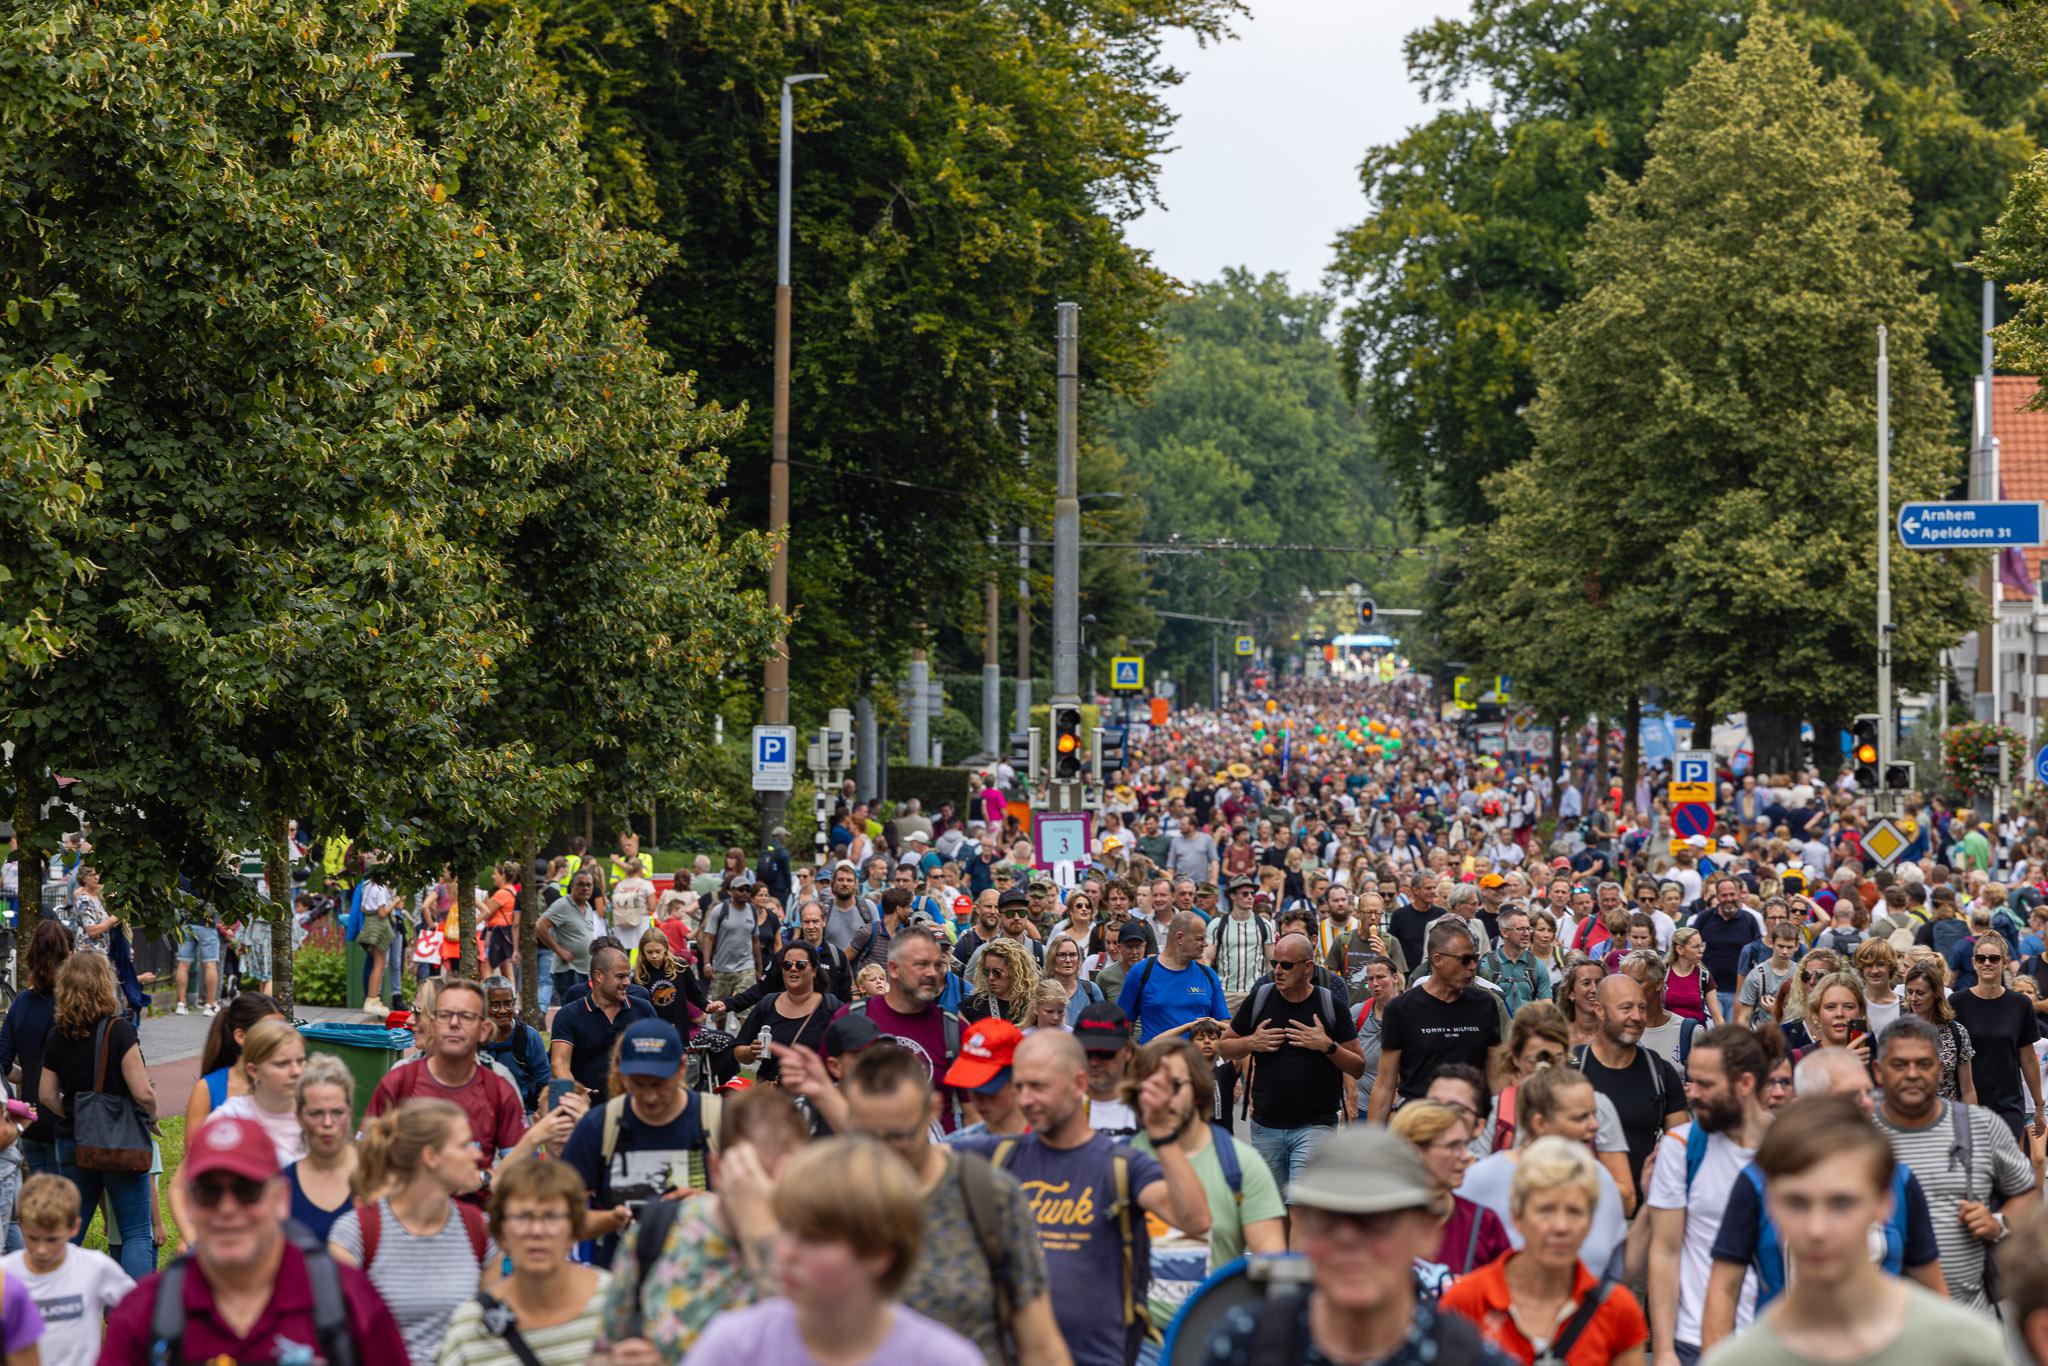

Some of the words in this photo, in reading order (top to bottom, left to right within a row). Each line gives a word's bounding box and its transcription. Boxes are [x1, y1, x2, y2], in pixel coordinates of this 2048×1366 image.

[1921, 509, 1975, 521] Arnhem
[1921, 526, 1993, 541] Apeldoorn
[1997, 528, 2011, 538] 31
[765, 739, 781, 760] P
[1686, 763, 1702, 781] P
[1060, 838, 1069, 854] 3
